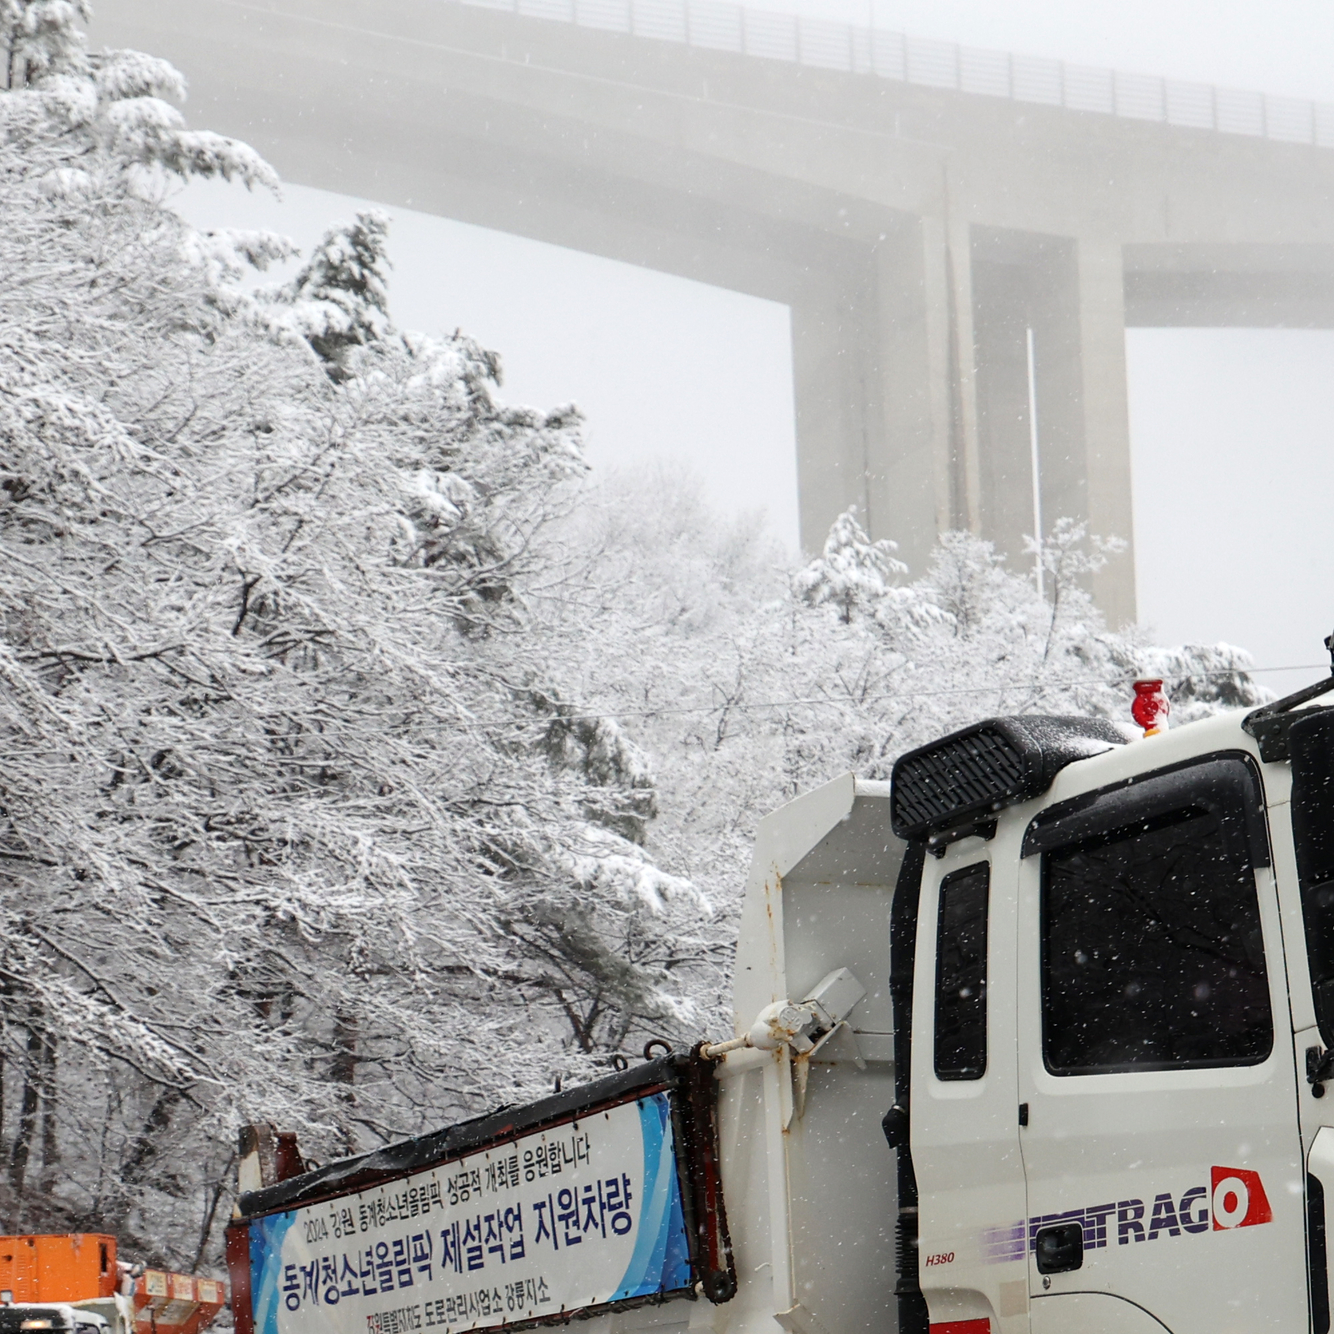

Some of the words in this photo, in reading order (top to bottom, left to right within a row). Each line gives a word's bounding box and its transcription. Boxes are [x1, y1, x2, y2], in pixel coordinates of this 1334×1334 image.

[303, 1217, 328, 1244] 2024
[330, 1207, 355, 1239] 강원
[359, 1180, 444, 1232] 동계청소년올림픽
[447, 1167, 482, 1205] 성공적
[485, 1154, 520, 1193] 개최를
[522, 1132, 591, 1183] 응원합니다
[1081, 1175, 1252, 1250] TRAGO
[282, 1229, 433, 1311] 동계청소년올림픽
[440, 1203, 527, 1274] 제설작업
[533, 1173, 633, 1250] 지원차량
[925, 1251, 956, 1267] H380
[424, 1287, 503, 1327] 도로관리사업소
[504, 1275, 551, 1312] 강릉지소
